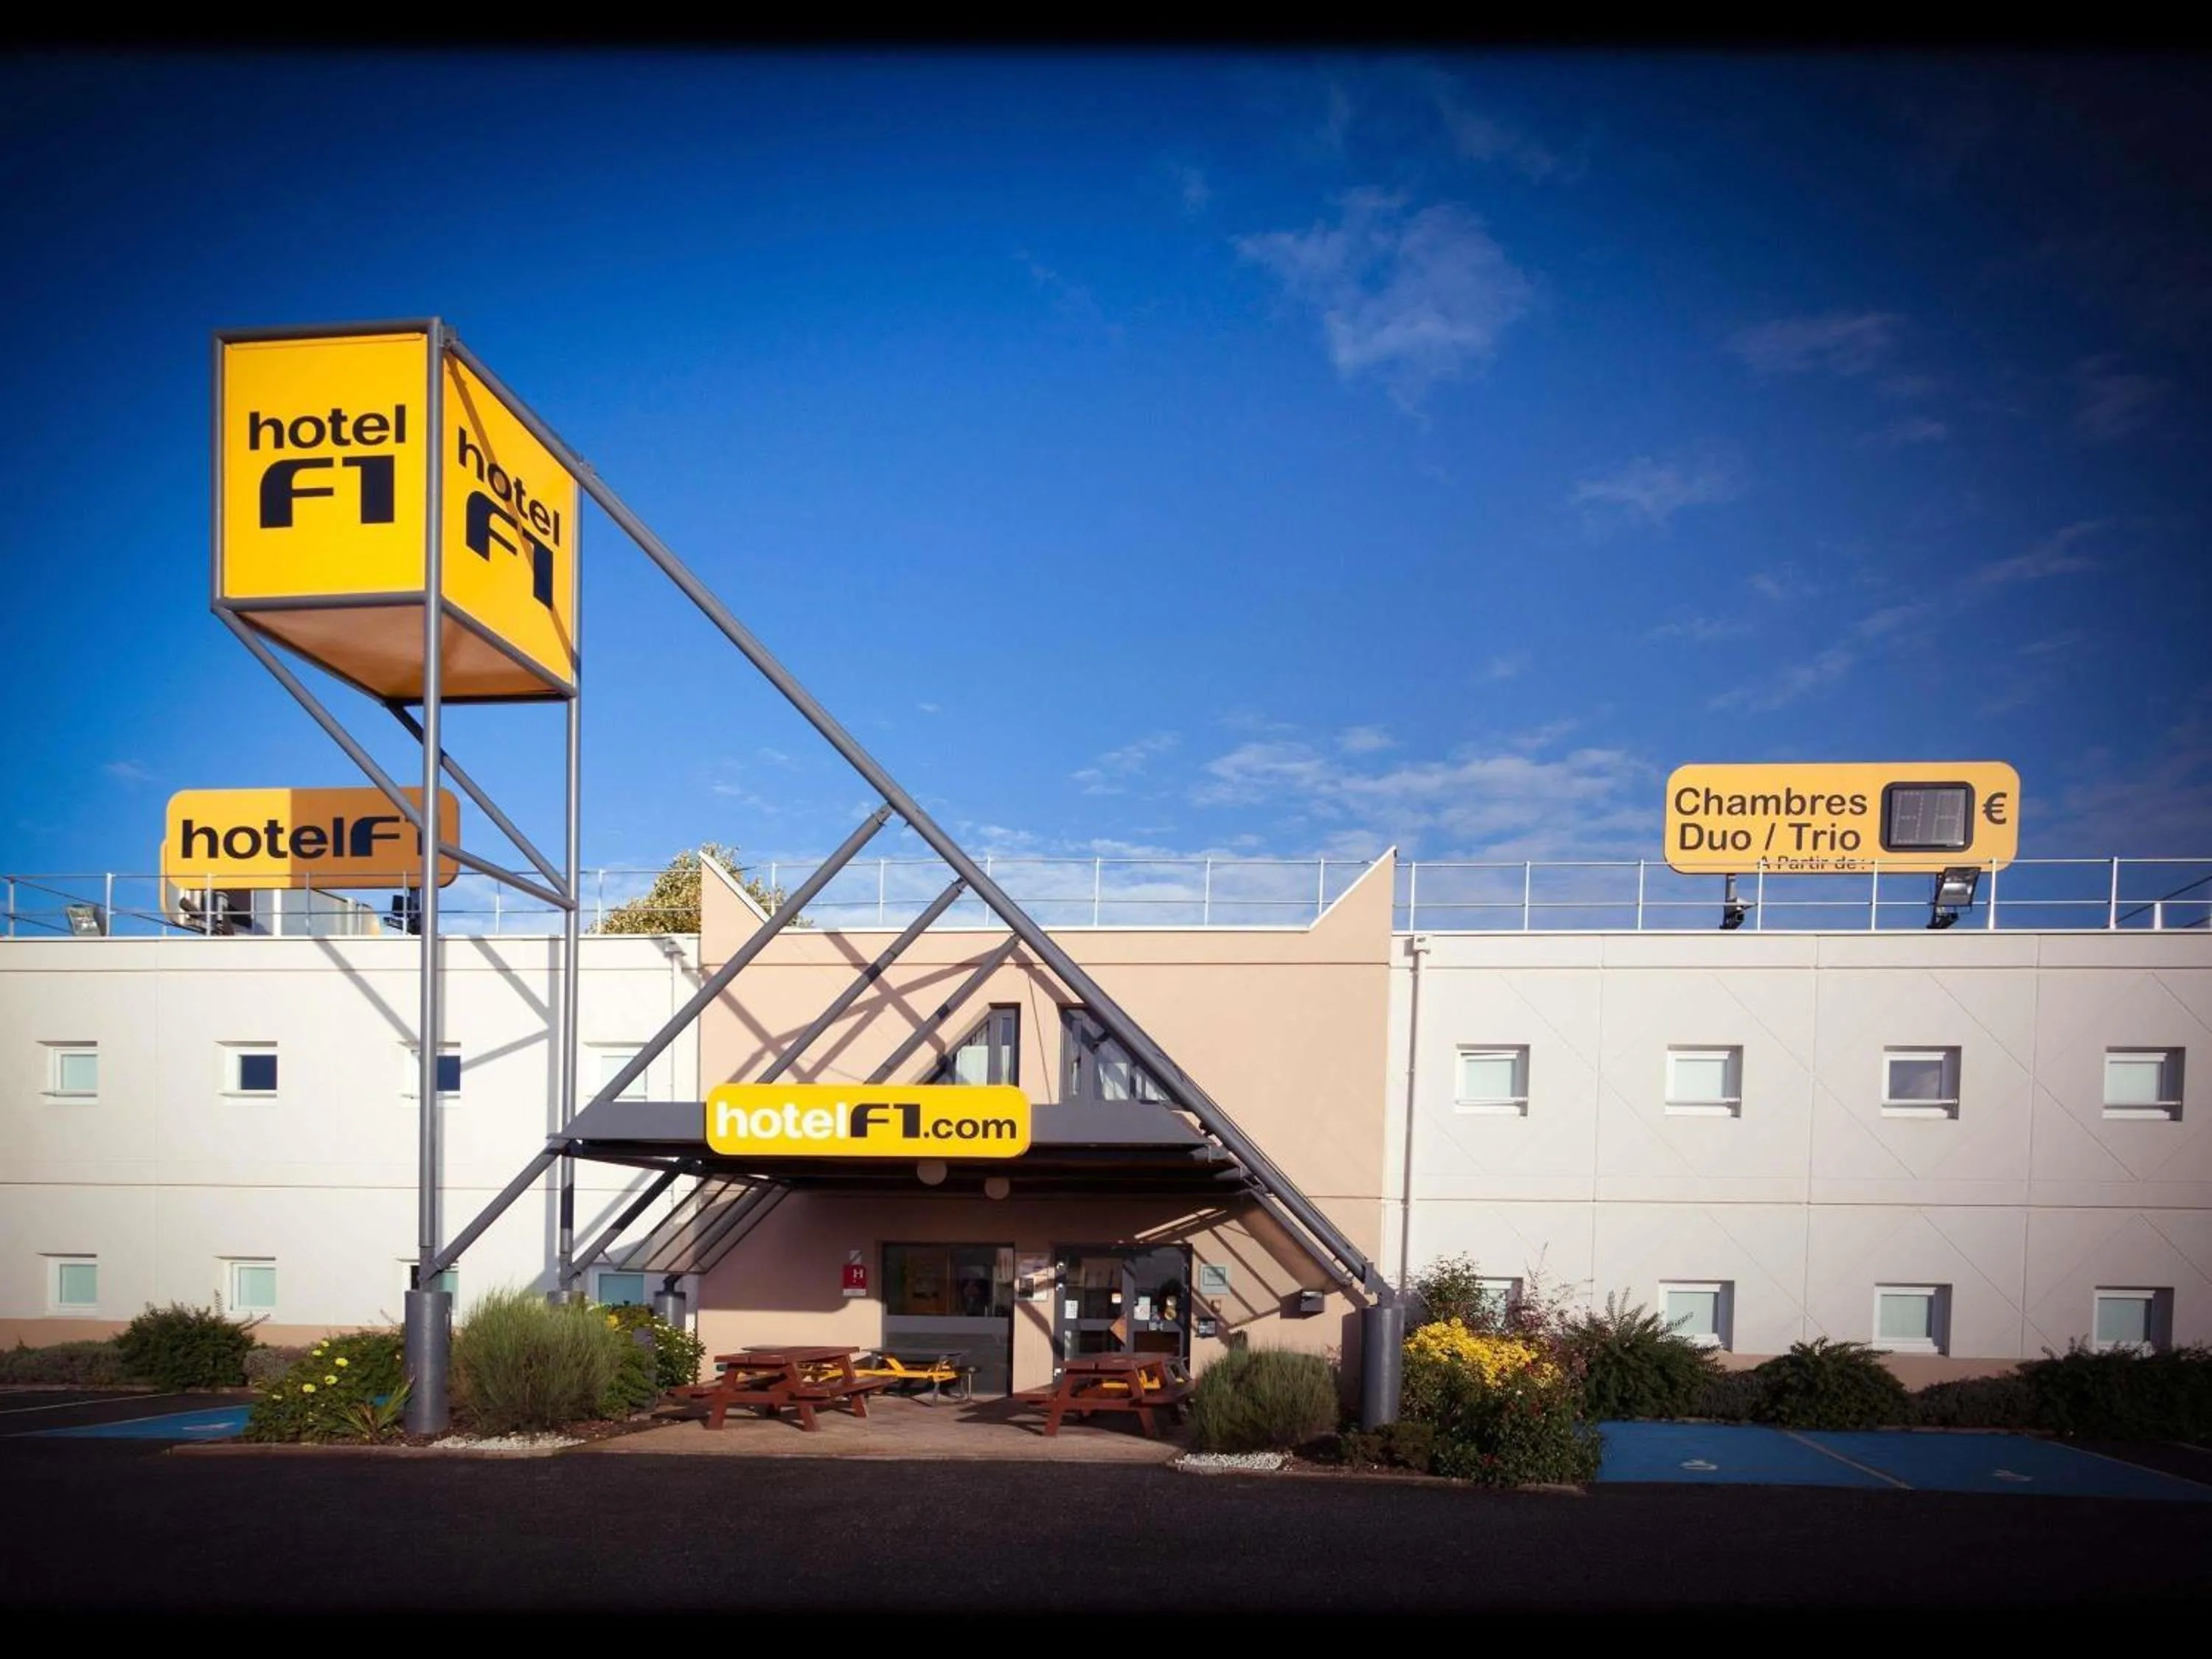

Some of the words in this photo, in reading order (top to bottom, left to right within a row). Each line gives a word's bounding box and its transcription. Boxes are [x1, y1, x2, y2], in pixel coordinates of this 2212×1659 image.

[249, 404, 406, 451] hotel
[260, 455, 394, 529] F1
[459, 425, 560, 547] hotel
[466, 490, 554, 611] F1
[1674, 787, 1868, 815] Chambres
[1983, 792, 2007, 825] €
[1680, 822, 1751, 851] Duo
[1764, 823, 1775, 850] /
[1788, 823, 1860, 851] Trio
[1778, 855, 1829, 870] Partir
[716, 1102, 1017, 1139] hotelF1.com
